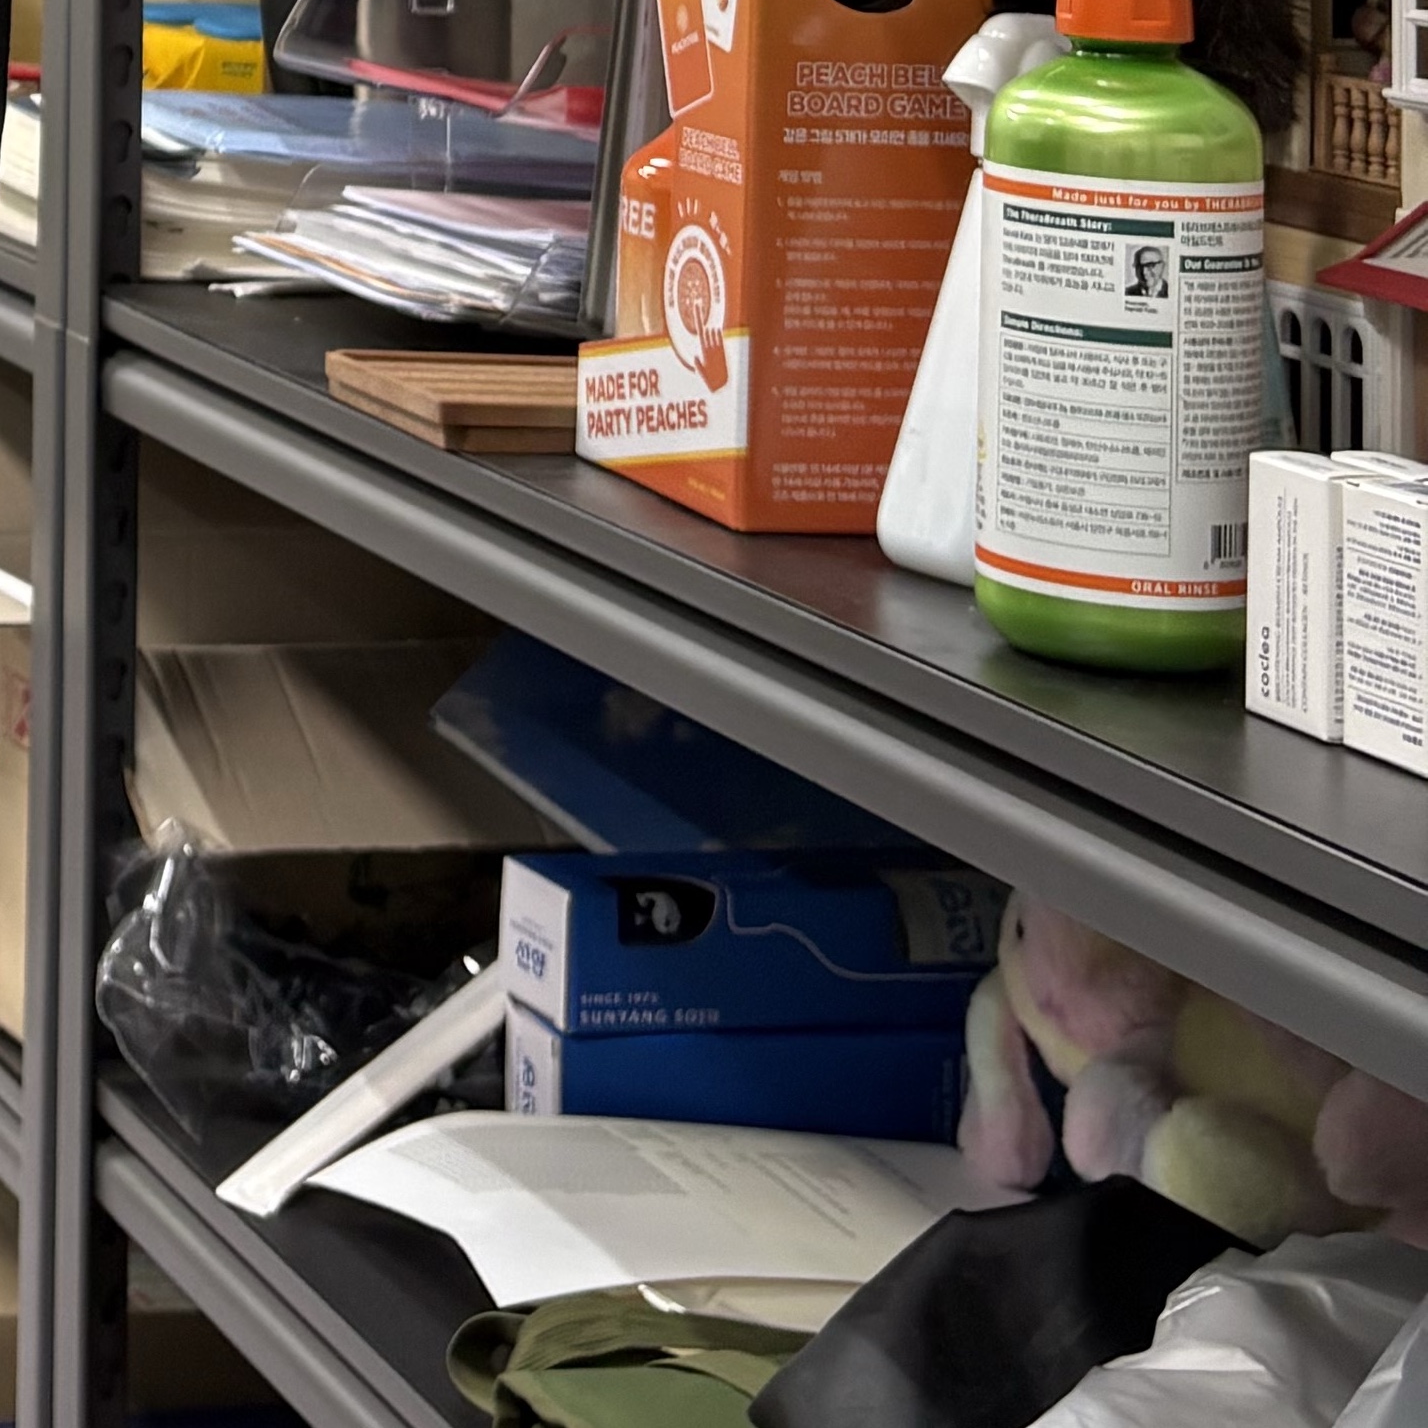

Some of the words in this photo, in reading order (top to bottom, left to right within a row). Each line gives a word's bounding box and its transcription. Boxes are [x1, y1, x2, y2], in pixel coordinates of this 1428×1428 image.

[796, 60, 888, 88] PEACH
[891, 64, 945, 89] BEL
[787, 91, 883, 118] BOARD
[887, 94, 968, 120] GAME
[1052, 187, 1087, 203] Made
[1094, 192, 1123, 208] just
[1127, 194, 1149, 208] for
[1154, 197, 1180, 212] you
[1183, 197, 1200, 212] by
[585, 372, 626, 404] MADE
[628, 369, 661, 398] FOR
[586, 404, 632, 439] PARTY
[636, 400, 709, 434] PEACHES
[1131, 579, 1171, 594] ORAL
[1177, 581, 1219, 596] RINSE
